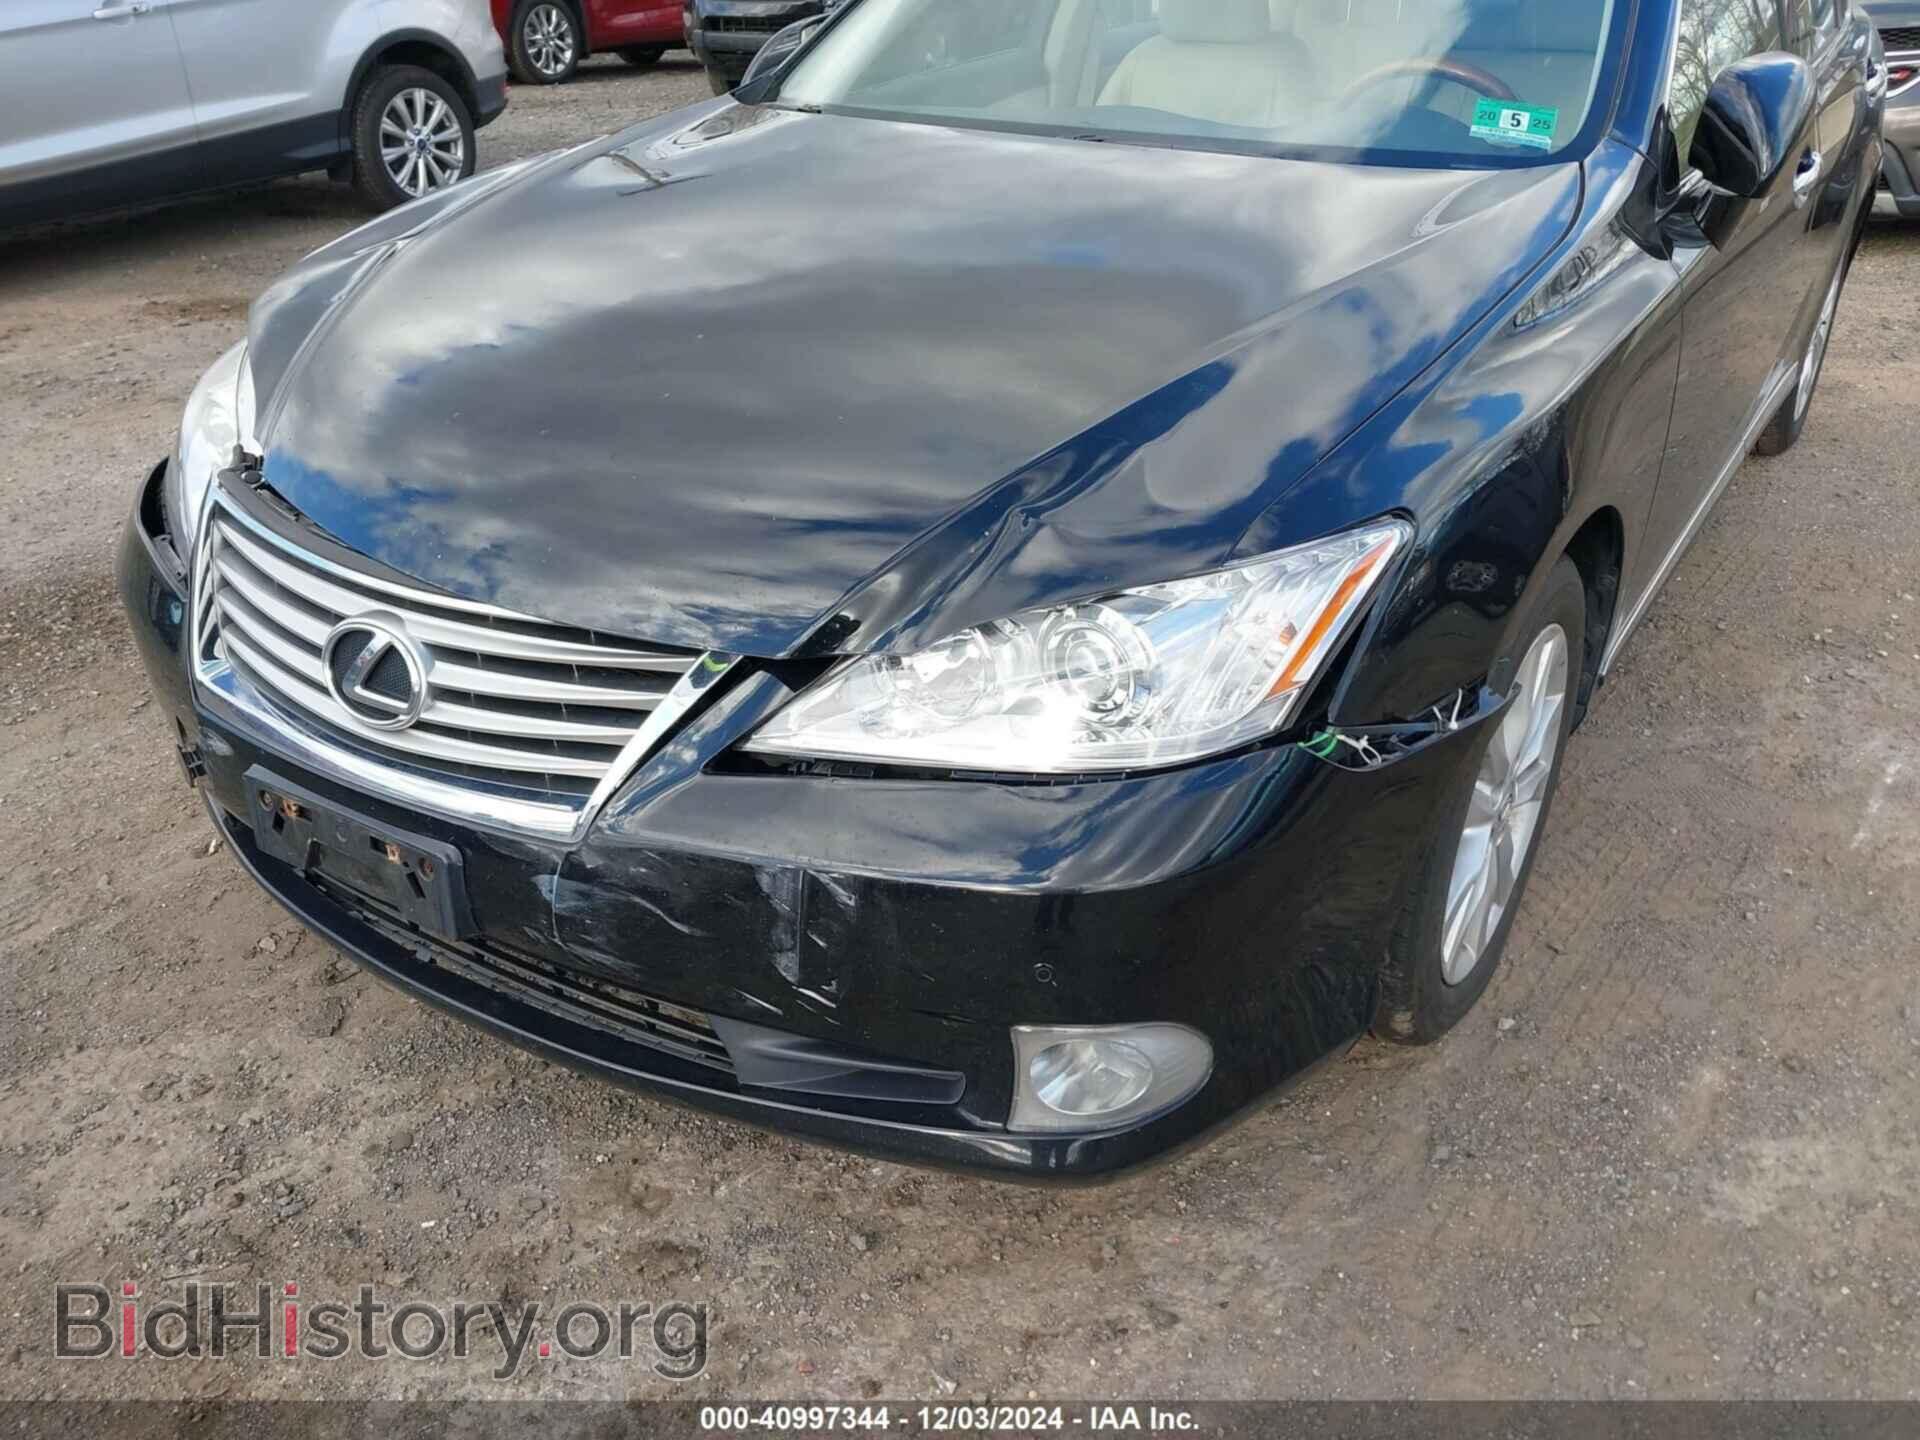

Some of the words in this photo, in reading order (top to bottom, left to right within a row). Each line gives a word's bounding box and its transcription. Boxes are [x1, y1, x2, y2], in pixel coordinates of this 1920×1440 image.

[1478, 111, 1496, 121] 20
[1510, 113, 1521, 127] 5
[1533, 119, 1551, 130] 25
